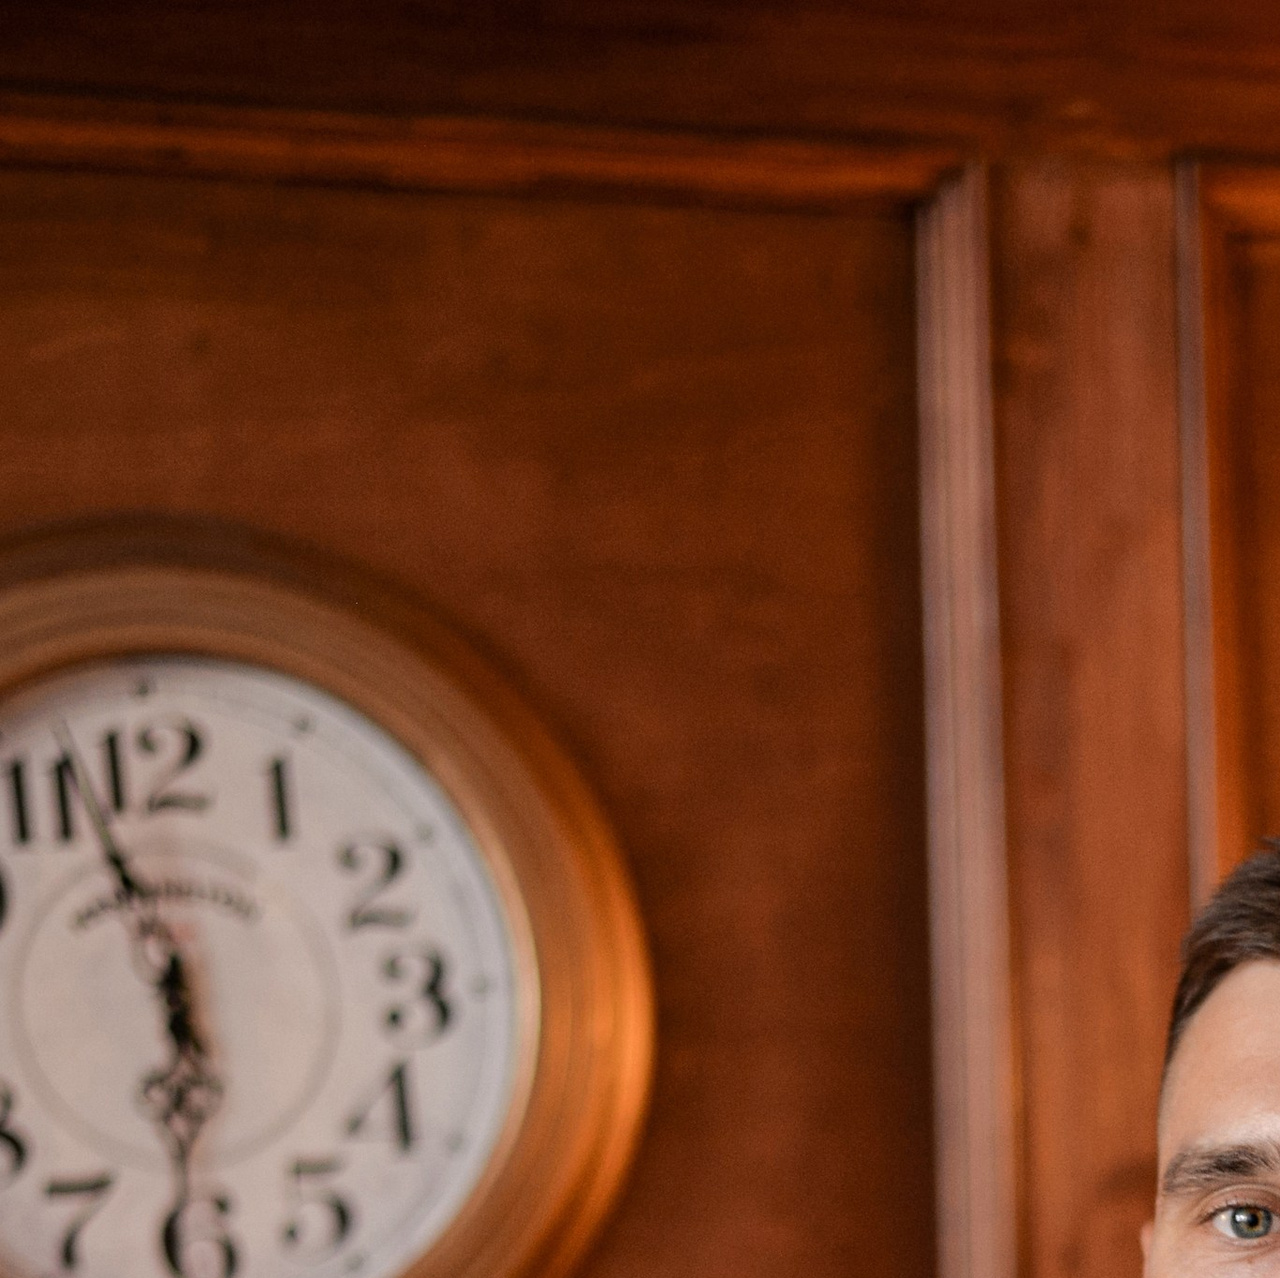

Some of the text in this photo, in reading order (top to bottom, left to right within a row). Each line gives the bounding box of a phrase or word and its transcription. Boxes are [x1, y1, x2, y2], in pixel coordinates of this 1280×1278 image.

[6, 750, 76, 844] 11
[101, 716, 208, 816] 12
[267, 754, 295, 841] 1
[338, 832, 411, 928] 2
[383, 944, 453, 1050] 3
[345, 1060, 415, 1154] 4
[45, 1172, 112, 1270] 7
[281, 1157, 353, 1259] 5
